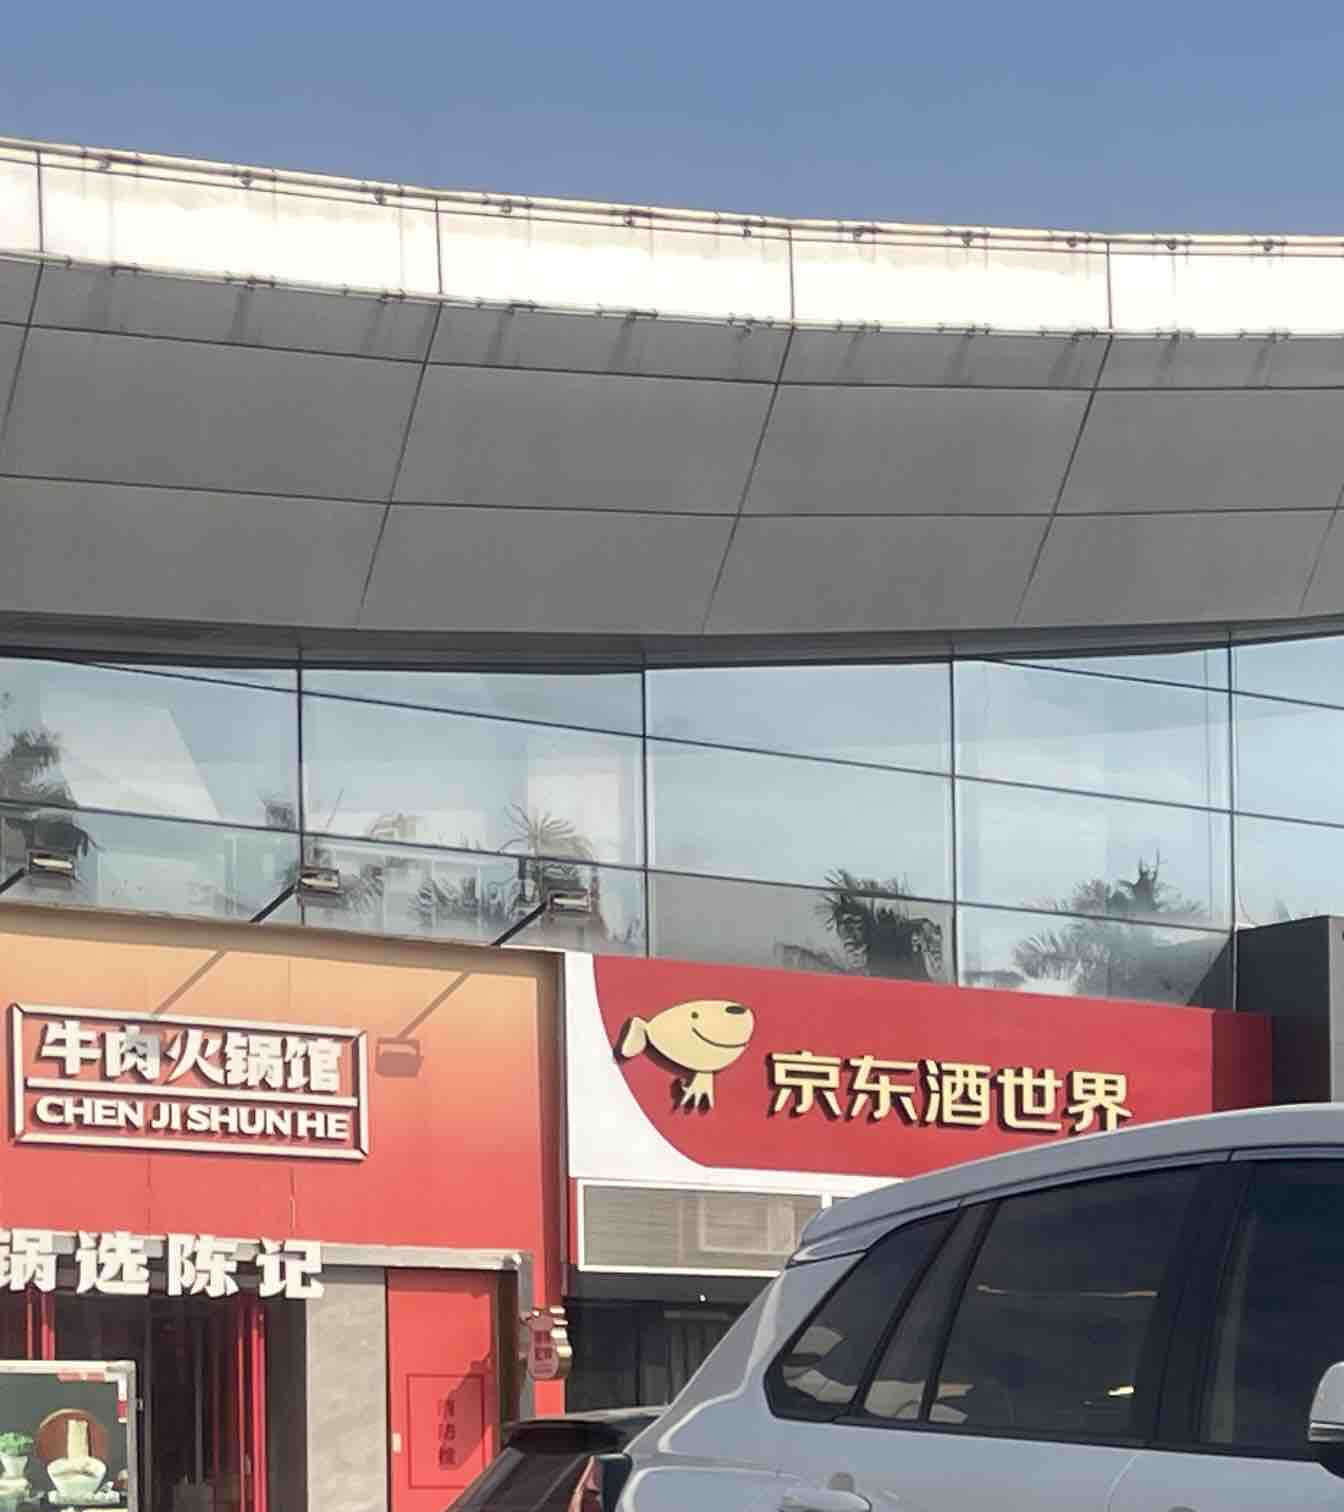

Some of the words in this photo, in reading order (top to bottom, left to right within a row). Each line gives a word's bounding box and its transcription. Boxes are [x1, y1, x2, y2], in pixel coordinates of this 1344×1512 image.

[39, 1019, 342, 1093] 牛肉火锅馆
[769, 1049, 1132, 1133] 京东酒世界
[36, 1095, 144, 1129] CHEN
[152, 1102, 182, 1131] JI
[187, 1105, 292, 1138] SHUN
[300, 1111, 349, 1141] HE
[0, 1228, 325, 1299] 锅选陈记
